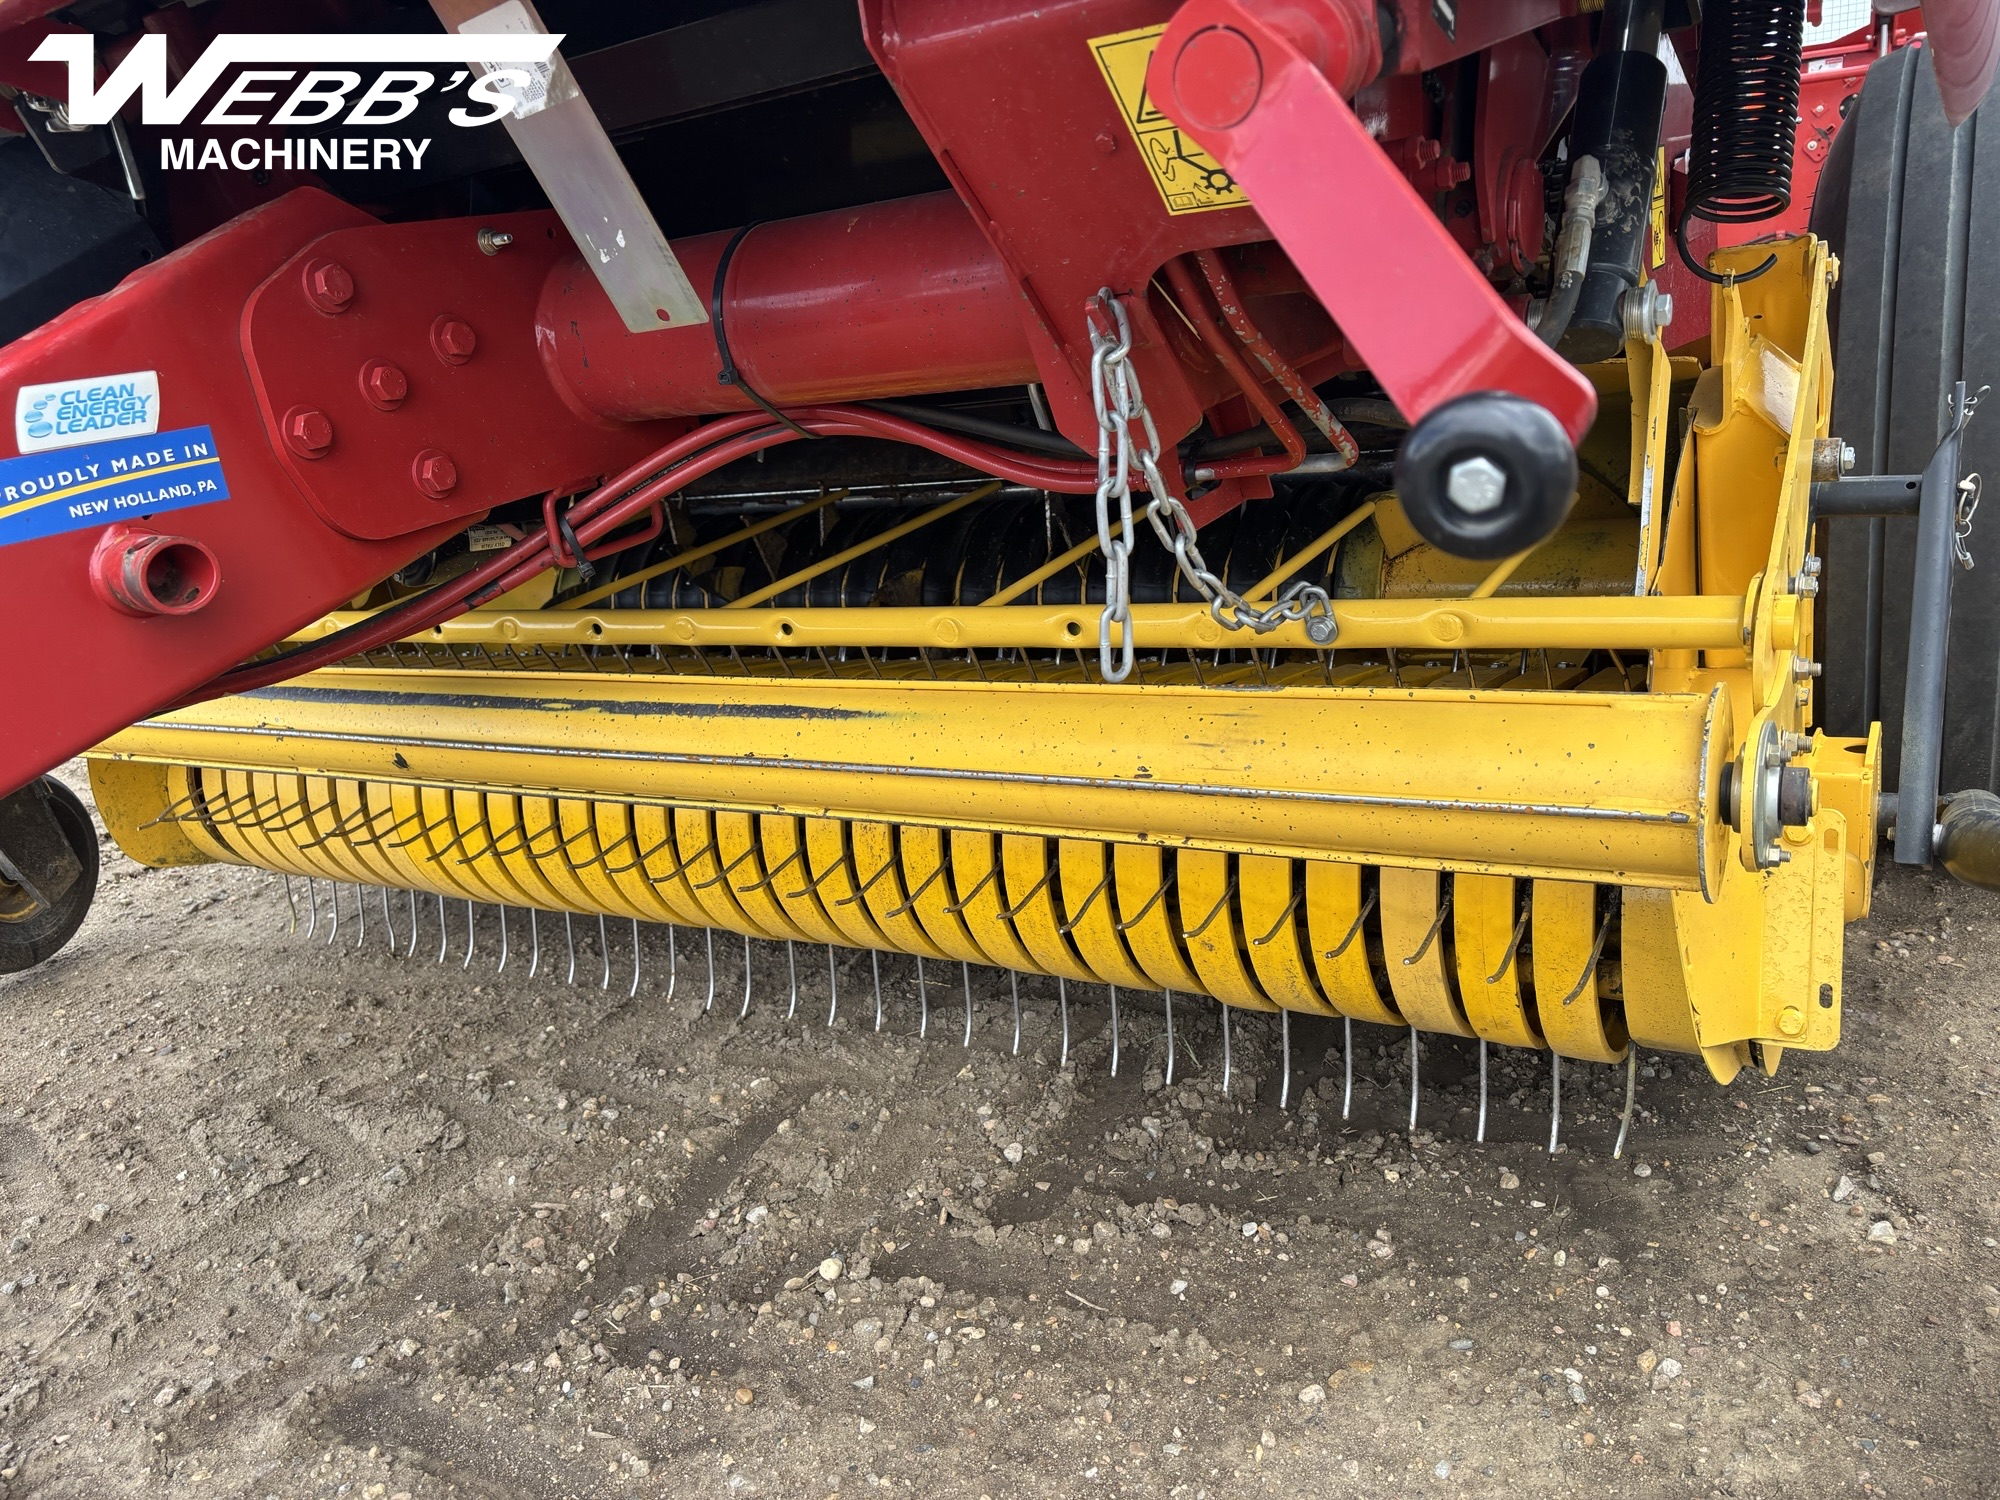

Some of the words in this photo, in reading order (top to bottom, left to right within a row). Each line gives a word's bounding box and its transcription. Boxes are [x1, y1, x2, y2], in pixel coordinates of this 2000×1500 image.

[56, 394, 153, 421] ENERGY
[60, 383, 135, 406] CLEAN
[55, 409, 147, 435] LEADER
[0, 463, 100, 502] ROUDLY
[110, 448, 176, 474] MADE
[184, 442, 209, 459] IN
[68, 498, 110, 519] NEW
[113, 483, 197, 510] HOLLAND,
[197, 479, 218, 492] PA
